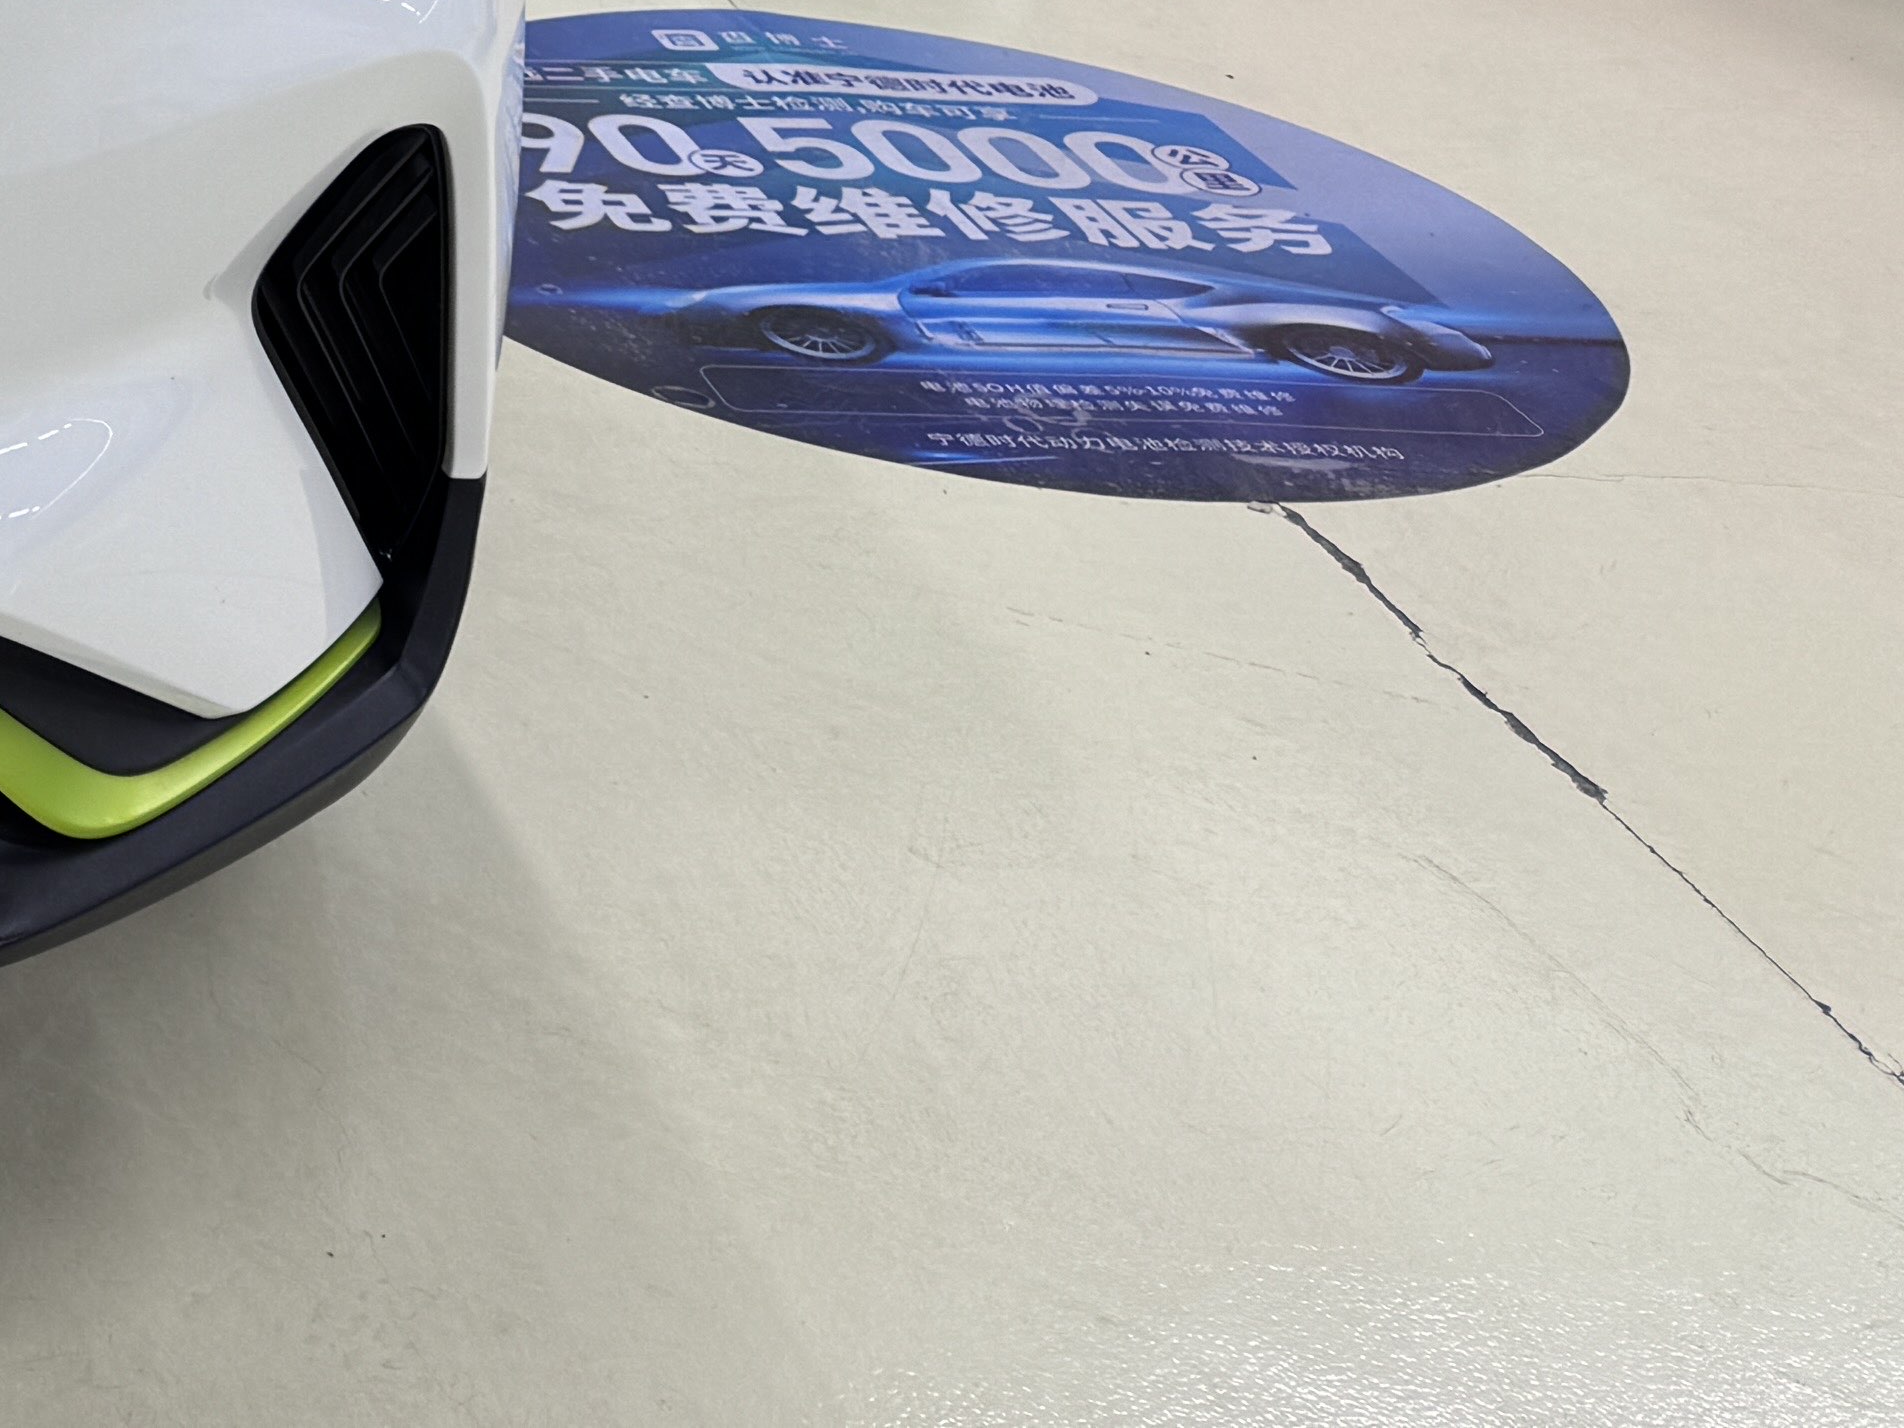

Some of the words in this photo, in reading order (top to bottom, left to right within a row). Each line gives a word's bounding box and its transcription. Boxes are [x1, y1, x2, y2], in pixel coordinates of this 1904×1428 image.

[525, 178, 1333, 256] 免费维修服务
